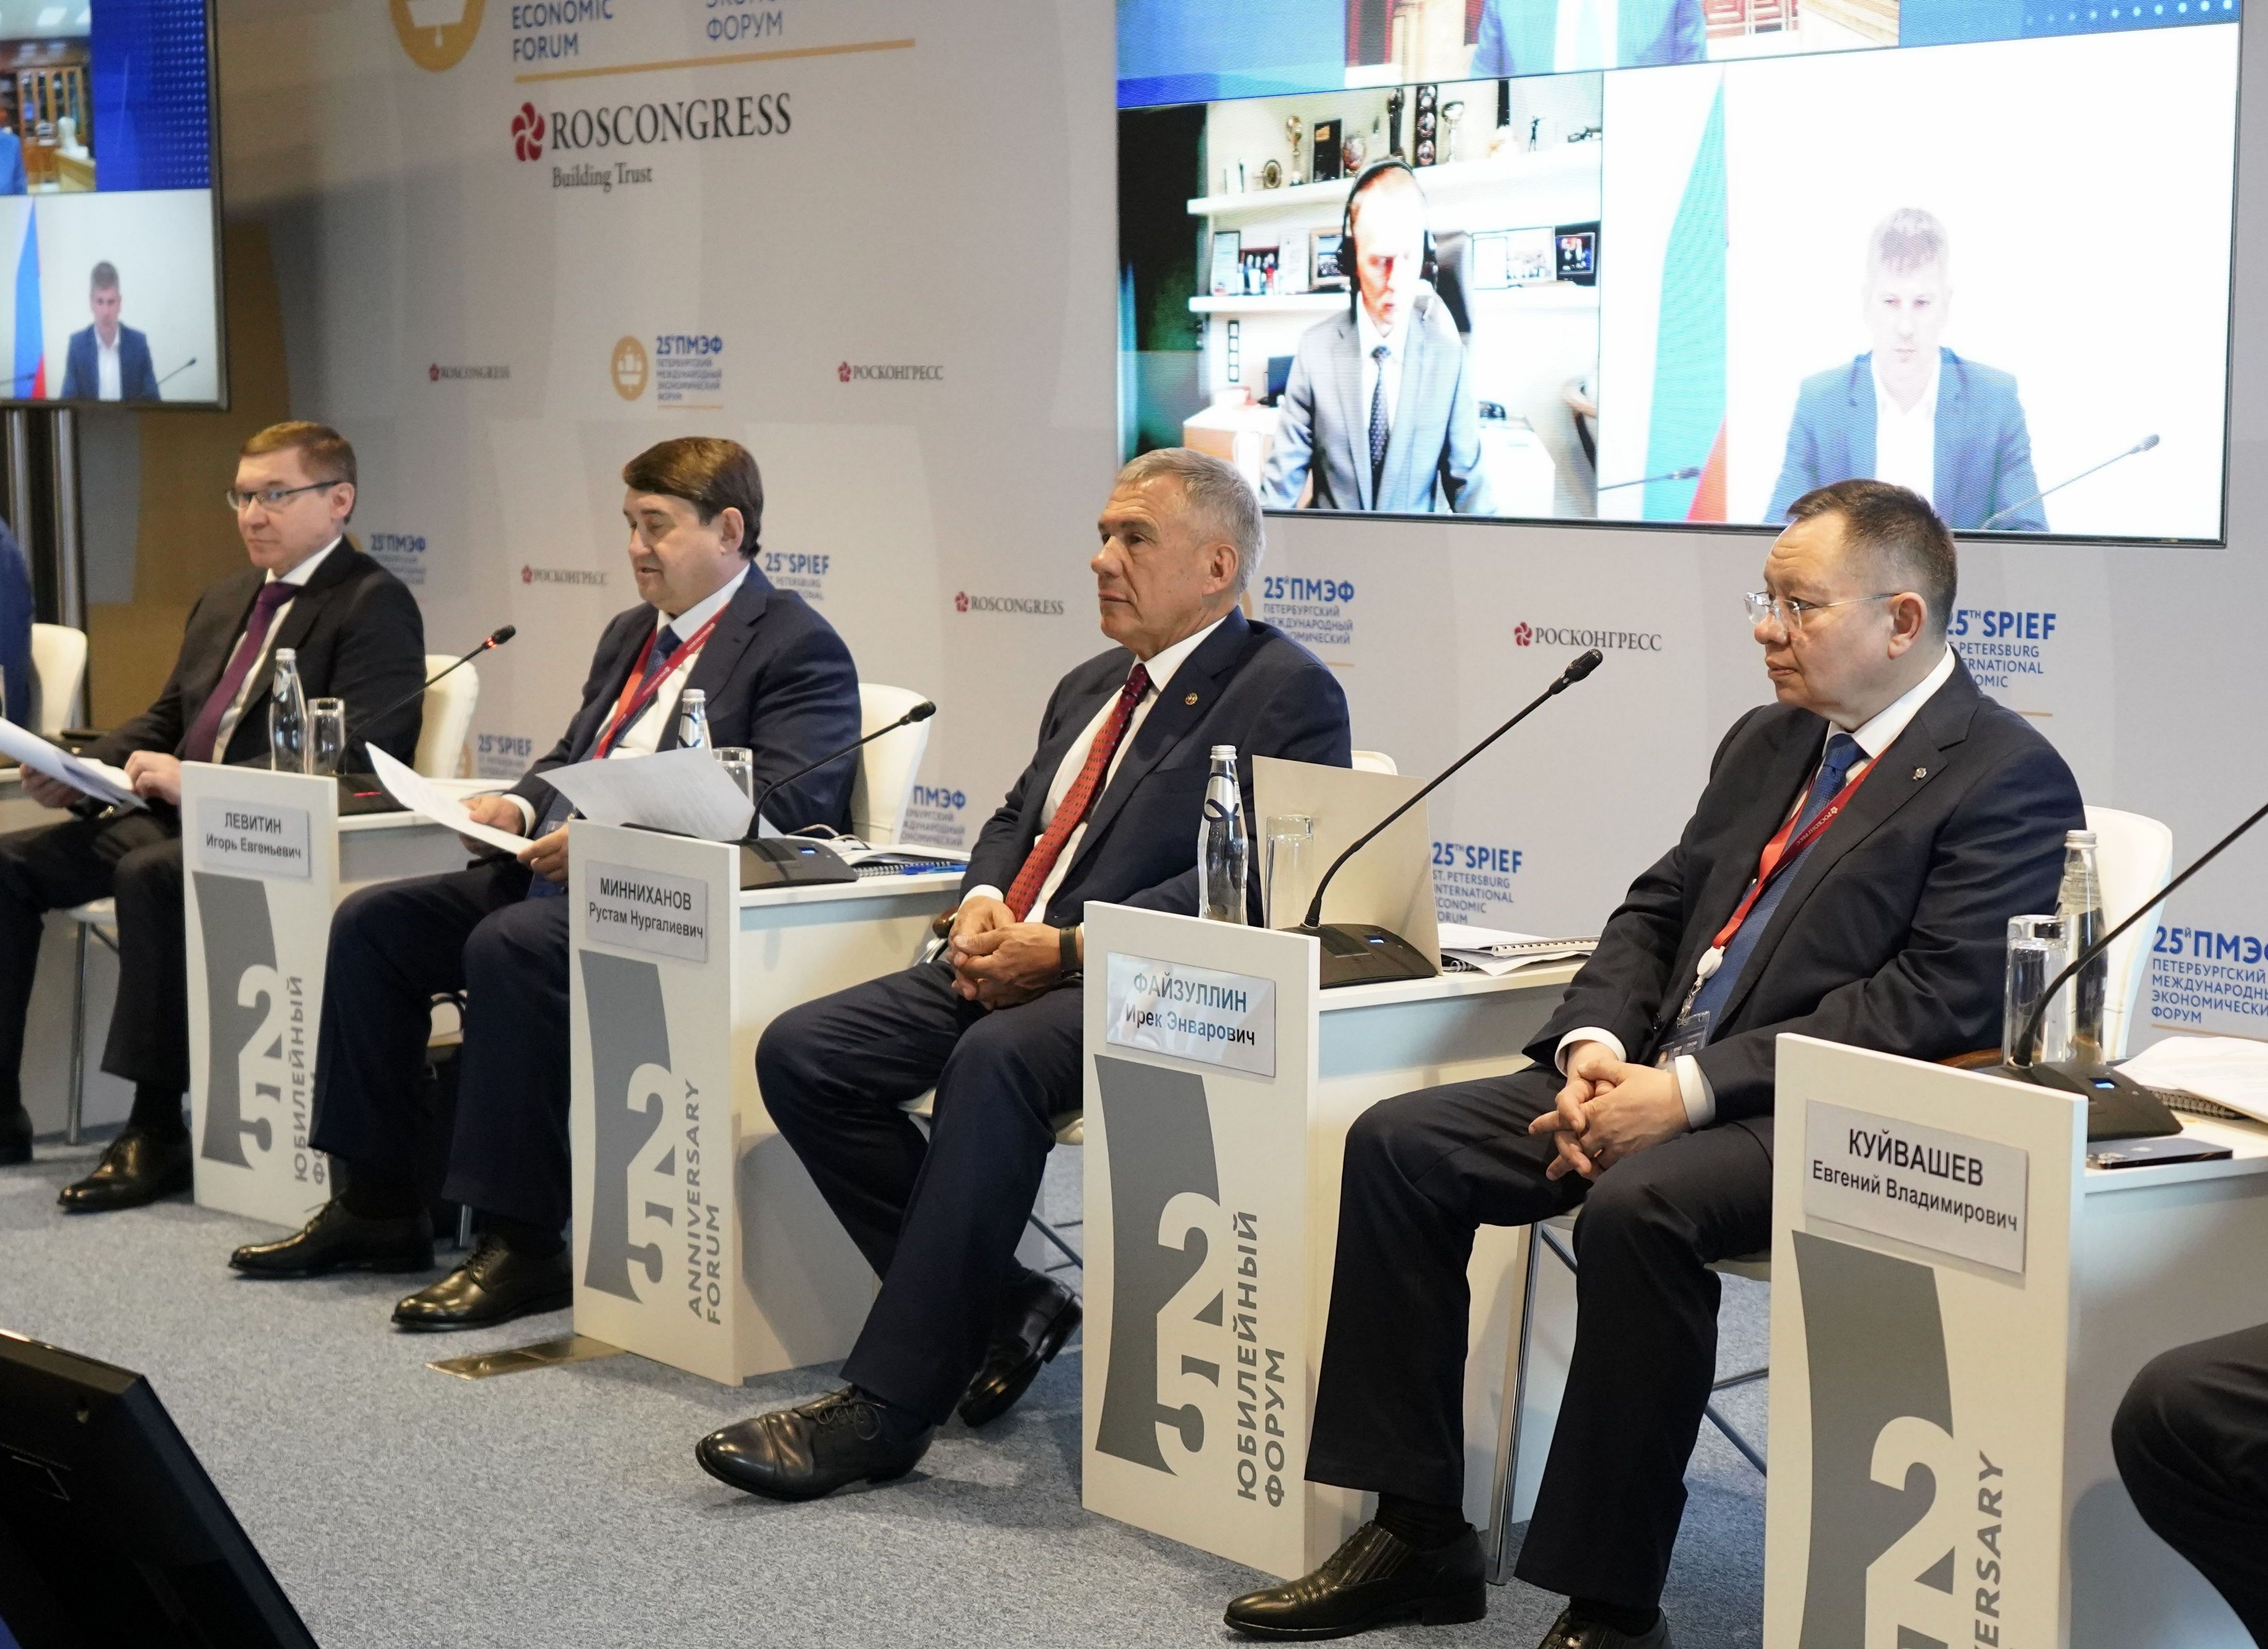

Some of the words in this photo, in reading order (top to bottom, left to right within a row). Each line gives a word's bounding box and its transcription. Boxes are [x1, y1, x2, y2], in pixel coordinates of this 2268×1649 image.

[512, 0, 613, 29] ECONOMIC
[706, 10, 783, 41] ФОРУМ
[513, 32, 579, 62] FORUM
[552, 93, 791, 149] ROSCONGRESS
[552, 164, 611, 192] Building
[616, 162, 652, 185] Trust
[853, 365, 944, 380] РОСКОНГРЕСС
[789, 553, 829, 574] SPIEF
[1291, 577, 1355, 603] ПМЭФ
[971, 596, 1064, 615] ROSCONGRESS
[1983, 610, 2056, 639] SPIEF
[1535, 627, 1662, 651] РОСКОНГРЕСС
[1959, 642, 2040, 658] PETERSBURG
[1963, 658, 2044, 674] RNATIONAL
[1974, 674, 2008, 688] OMIC
[913, 785, 966, 810] ПМЭФ
[225, 812, 281, 833] ЛЕВИТИН
[206, 833, 237, 852] Игорь
[240, 838, 301, 858] Евгеньевич
[1466, 846, 1523, 873] SPIEF
[601, 877, 691, 910] МИННИХАНОВ
[1448, 871, 1510, 888] PETERSBURG
[1435, 896, 1487, 913] CONOMIC
[1437, 911, 1468, 923] ORUM
[590, 902, 627, 923] Рустам
[631, 910, 703, 939] Нургалиевич
[2194, 930, 2268, 964] ПМЭ
[2153, 958, 2265, 984] ПЕТЕРБУРГСКИЙ
[1133, 972, 1246, 1013] ФАЙЗУЛЛИН
[2152, 974, 2268, 1000] МЕЖДУНАРОДН
[2151, 1006, 2202, 1023] ФОРУМ
[2152, 990, 2268, 1017] ЭКОНОМИЧЕСКИ
[1126, 1003, 1162, 1028] Ирек
[1167, 1011, 1255, 1045] Энварович
[286, 976, 307, 1182] ЮБИЛЕЙНЫЙ
[1849, 1129, 1983, 1186] КУЙВАШЕВ
[685, 1078, 702, 1319] ANNIVERSARY
[1813, 1160, 1880, 1195] Евгений
[1887, 1178, 2017, 1231] Владимирович
[706, 1204, 721, 1325] FORUM
[1233, 1210, 1257, 1501] ЮБИЛЕЙНЫЙ
[1265, 1348, 1284, 1508] ФОРУМ
[1975, 1450, 2003, 1649] ERSARY
